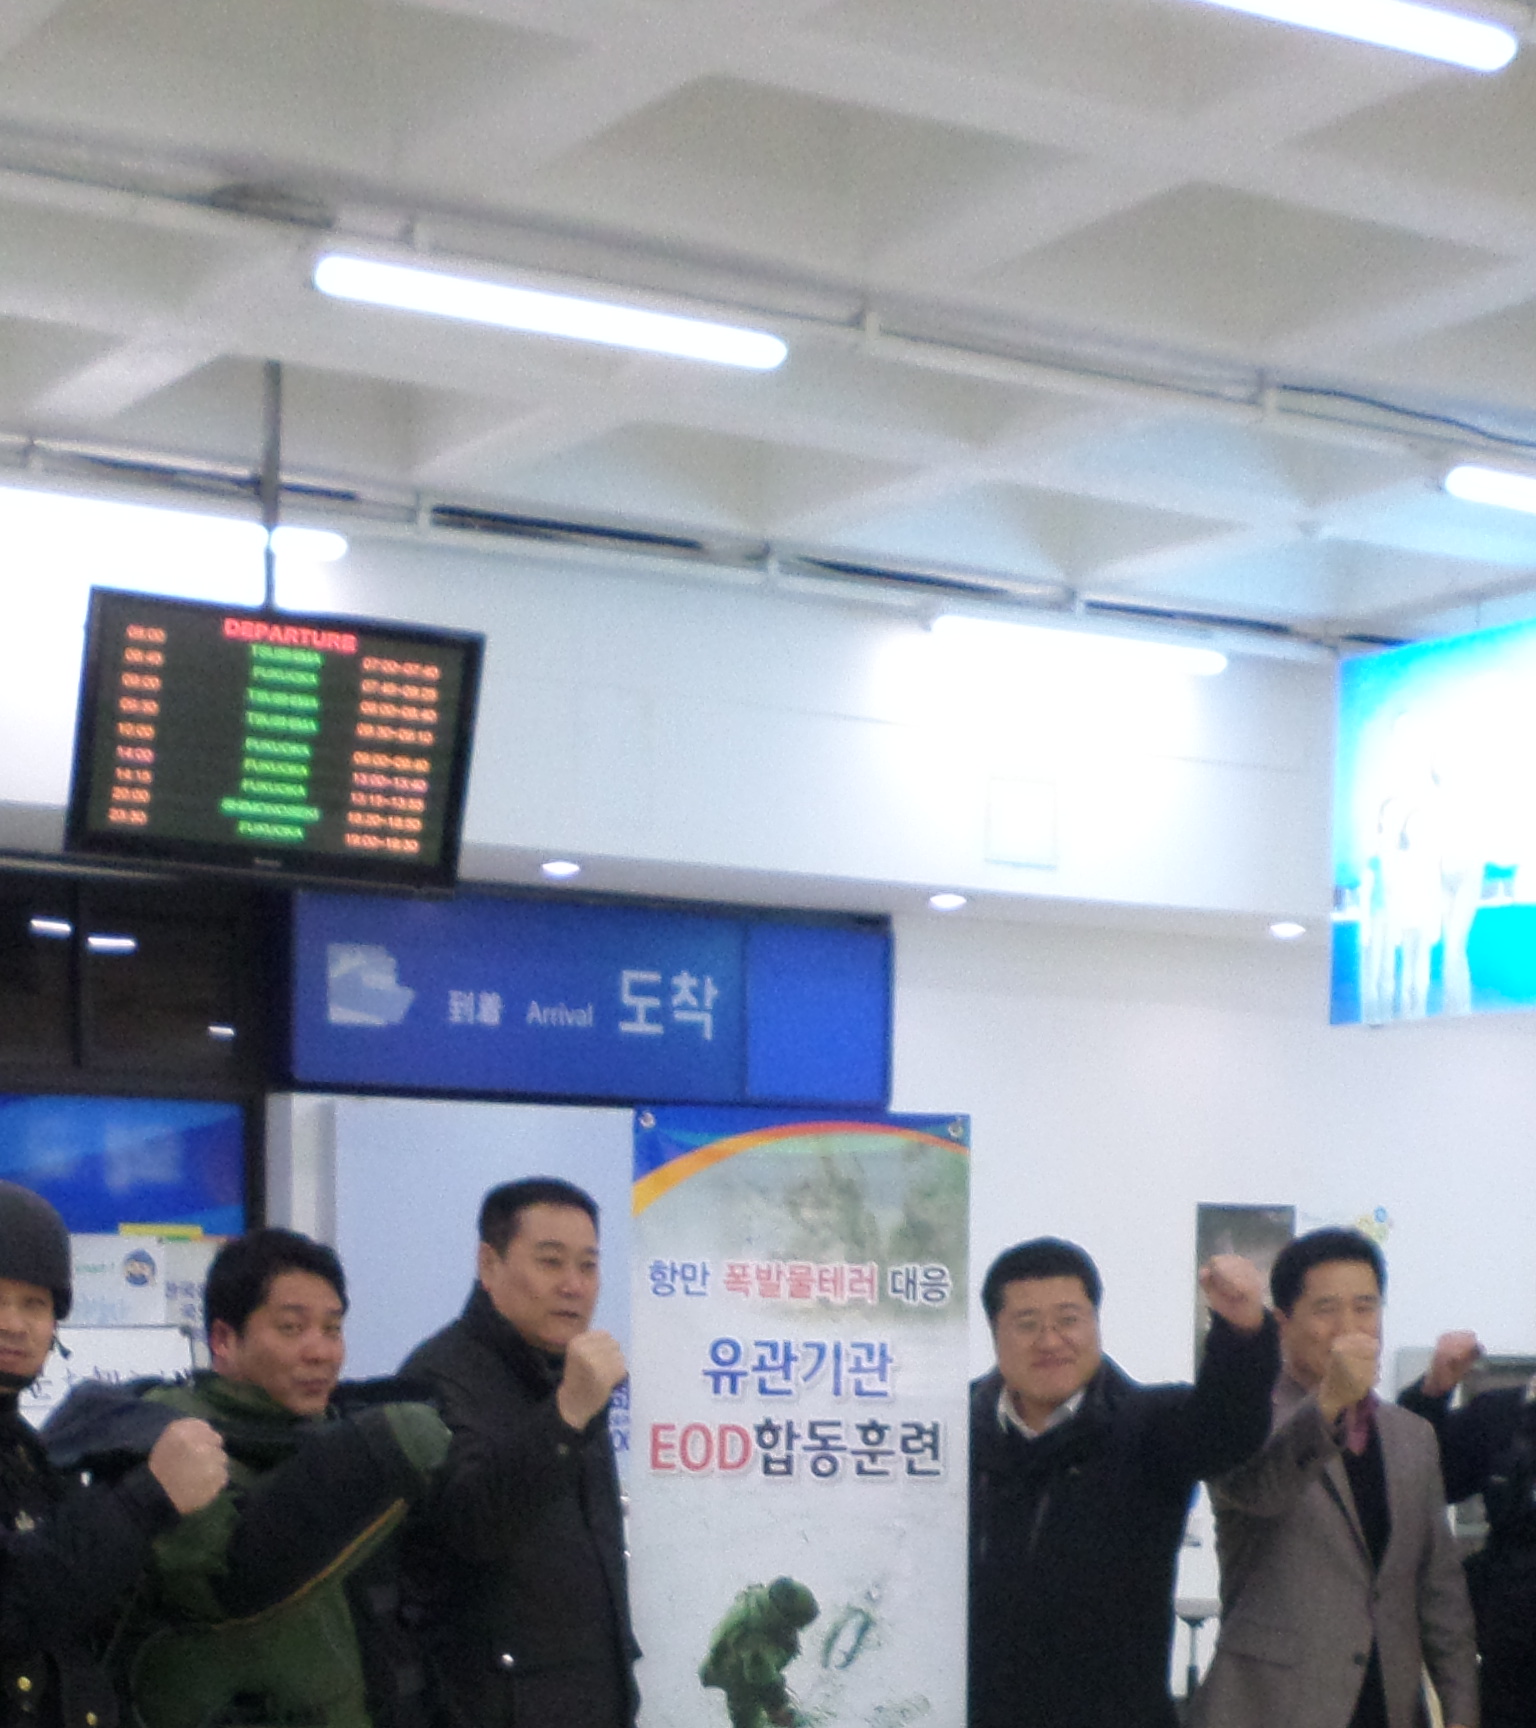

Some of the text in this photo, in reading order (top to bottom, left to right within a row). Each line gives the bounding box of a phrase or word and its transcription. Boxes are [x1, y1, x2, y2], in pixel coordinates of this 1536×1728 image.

[222, 617, 358, 655] DEPARTURE
[526, 1000, 594, 1028] Arrival
[618, 968, 719, 1041] 도착
[649, 1260, 952, 1305] 항만 폭발물테러 대응
[703, 1337, 893, 1398] 유관기관
[650, 1418, 942, 1478] EOD합동훈련
